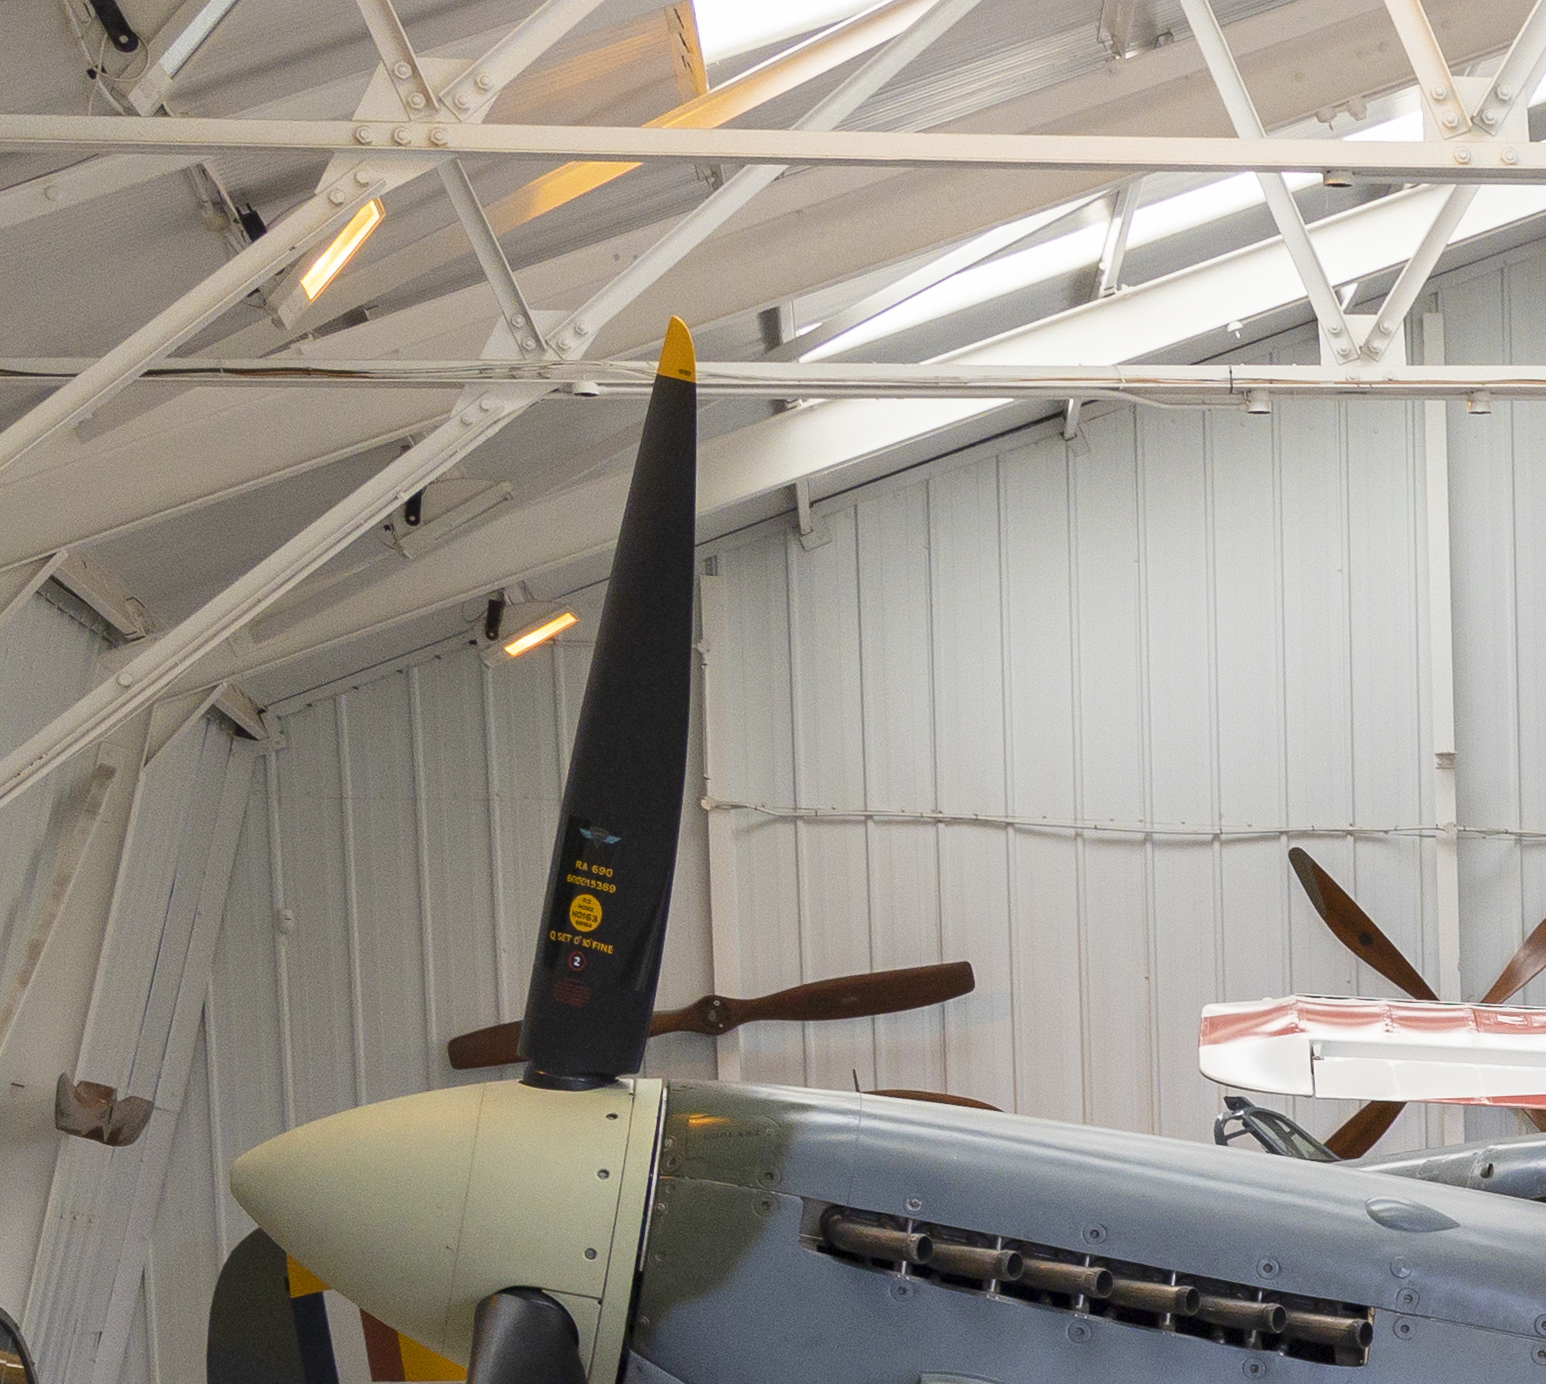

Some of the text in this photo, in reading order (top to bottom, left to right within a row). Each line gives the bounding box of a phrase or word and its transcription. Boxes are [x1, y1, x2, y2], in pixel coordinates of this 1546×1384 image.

[575, 860, 613, 878] RA 690
[592, 940, 614, 955] FINE
[573, 956, 581, 967] 2
